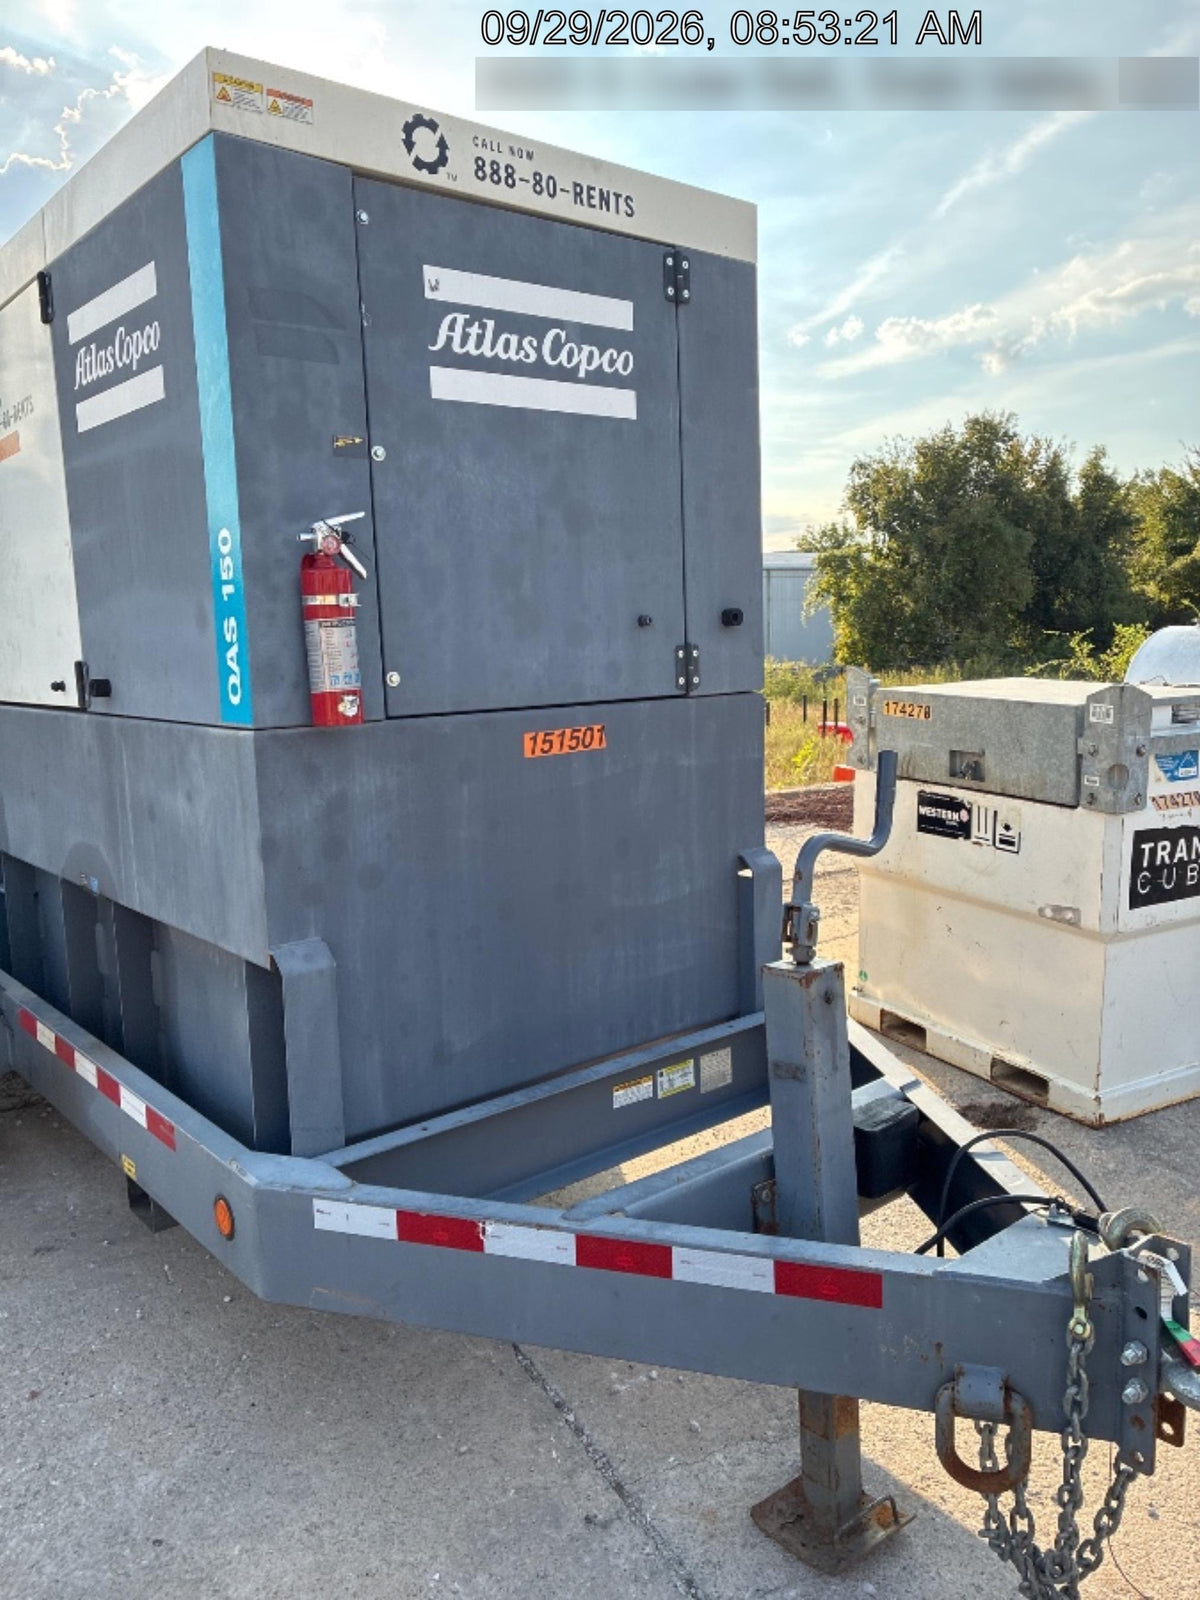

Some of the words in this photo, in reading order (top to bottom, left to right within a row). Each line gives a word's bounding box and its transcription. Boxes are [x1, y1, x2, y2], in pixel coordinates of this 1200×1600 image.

[472, 135, 502, 154] CALL
[508, 145, 535, 162] NOW
[474, 156, 635, 218] 888-80-RENTS
[74, 343, 115, 391] Atlas
[115, 321, 161, 370] Copco
[428, 313, 538, 364] Atlas
[542, 328, 634, 378] Copco
[217, 527, 236, 602] 150
[224, 615, 242, 706] QAS
[528, 725, 606, 755] 151501
